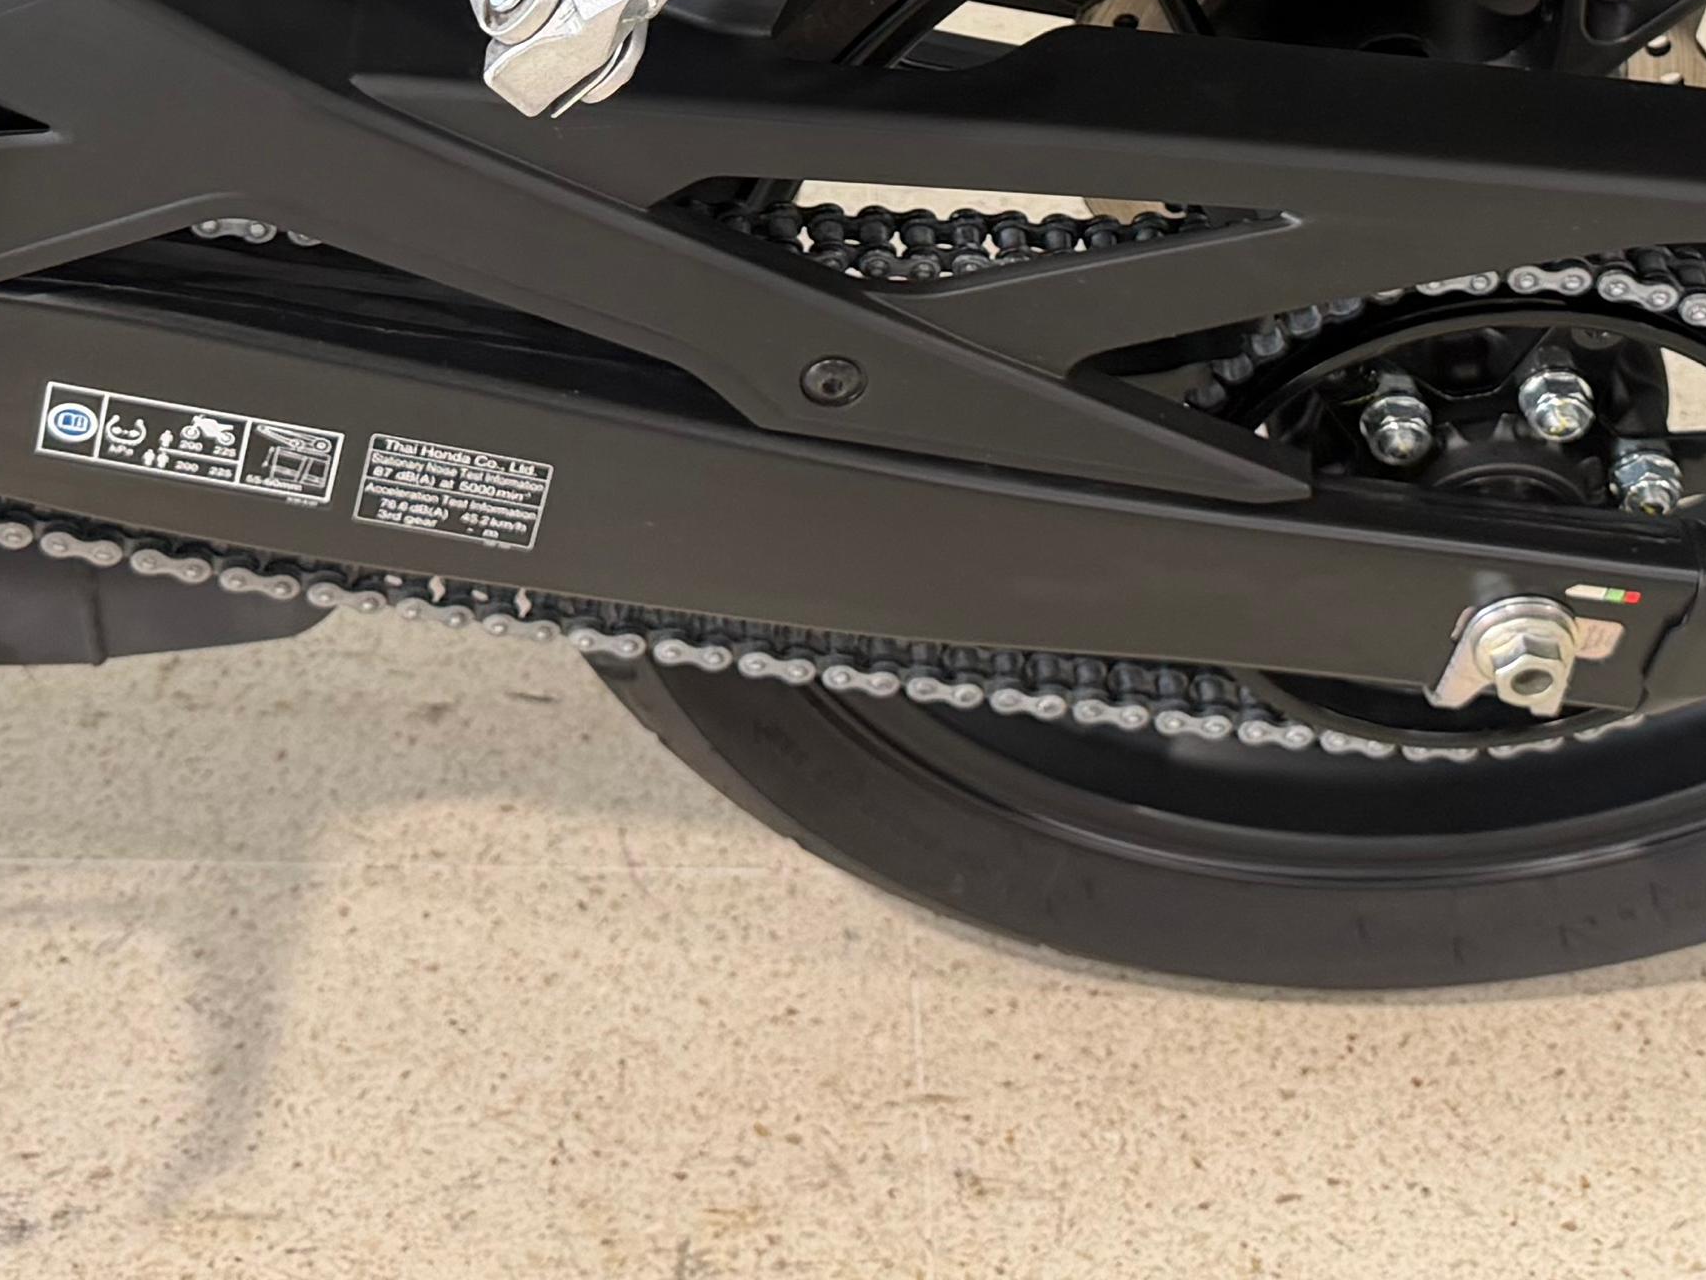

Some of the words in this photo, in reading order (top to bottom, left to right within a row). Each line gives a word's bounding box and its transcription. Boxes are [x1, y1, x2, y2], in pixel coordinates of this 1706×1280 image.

[385, 438, 417, 454] Thai
[420, 445, 471, 464] Honda
[508, 461, 537, 477] Ltd.
[439, 479, 454, 489] at
